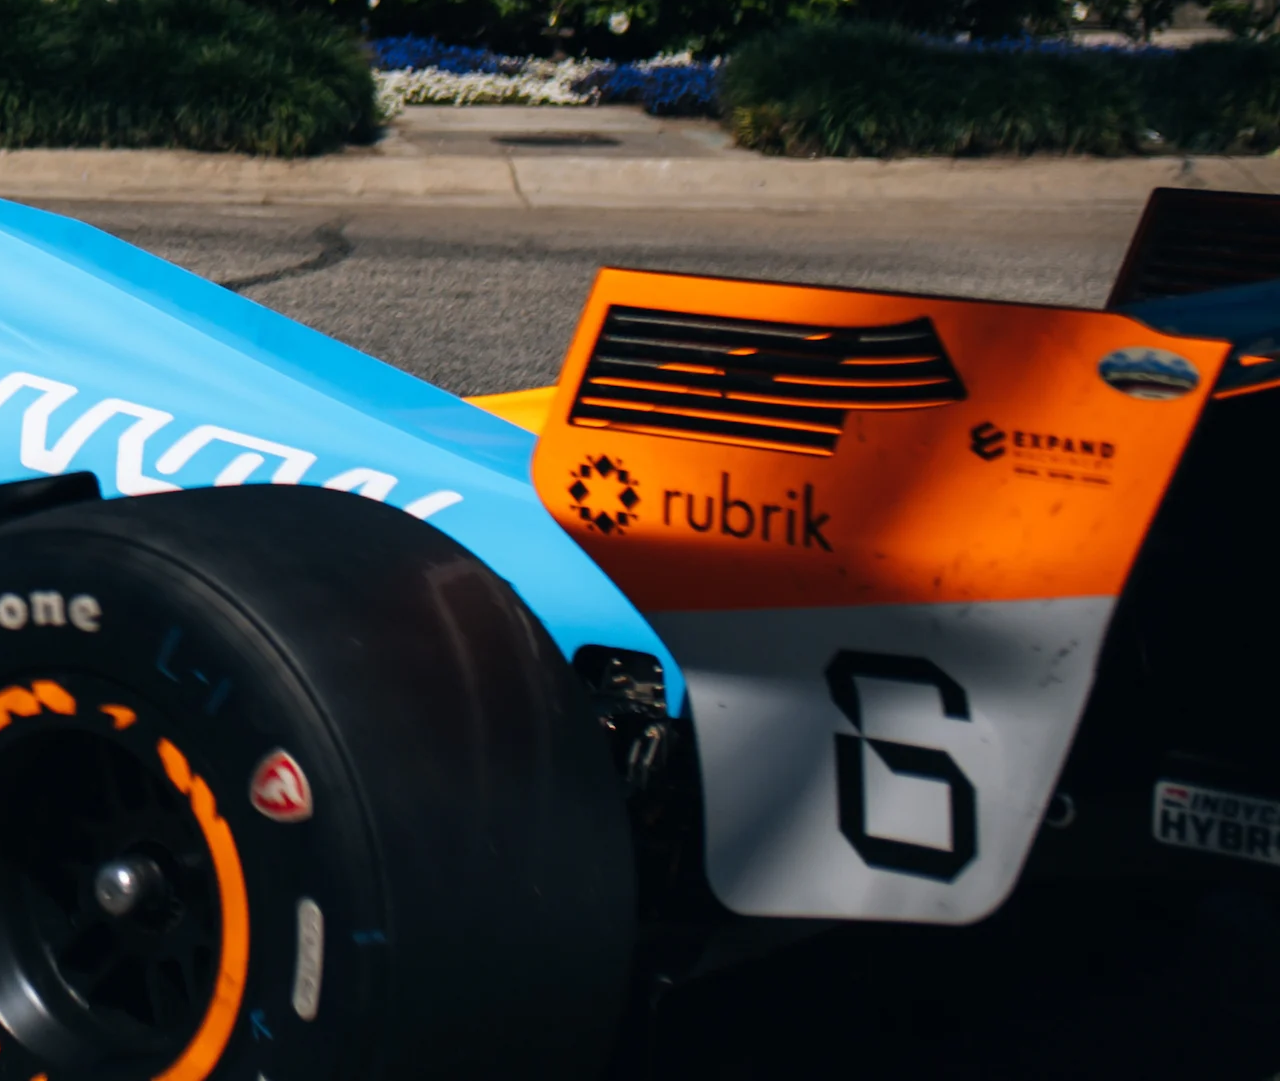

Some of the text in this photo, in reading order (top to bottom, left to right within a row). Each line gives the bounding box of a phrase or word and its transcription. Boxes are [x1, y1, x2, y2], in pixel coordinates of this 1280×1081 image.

[1013, 430, 1116, 459] EXPAND
[663, 471, 833, 553] rubrik
[823, 648, 978, 885] 6
[1191, 791, 1279, 825] INDYC
[1161, 810, 1280, 858] HYBR
